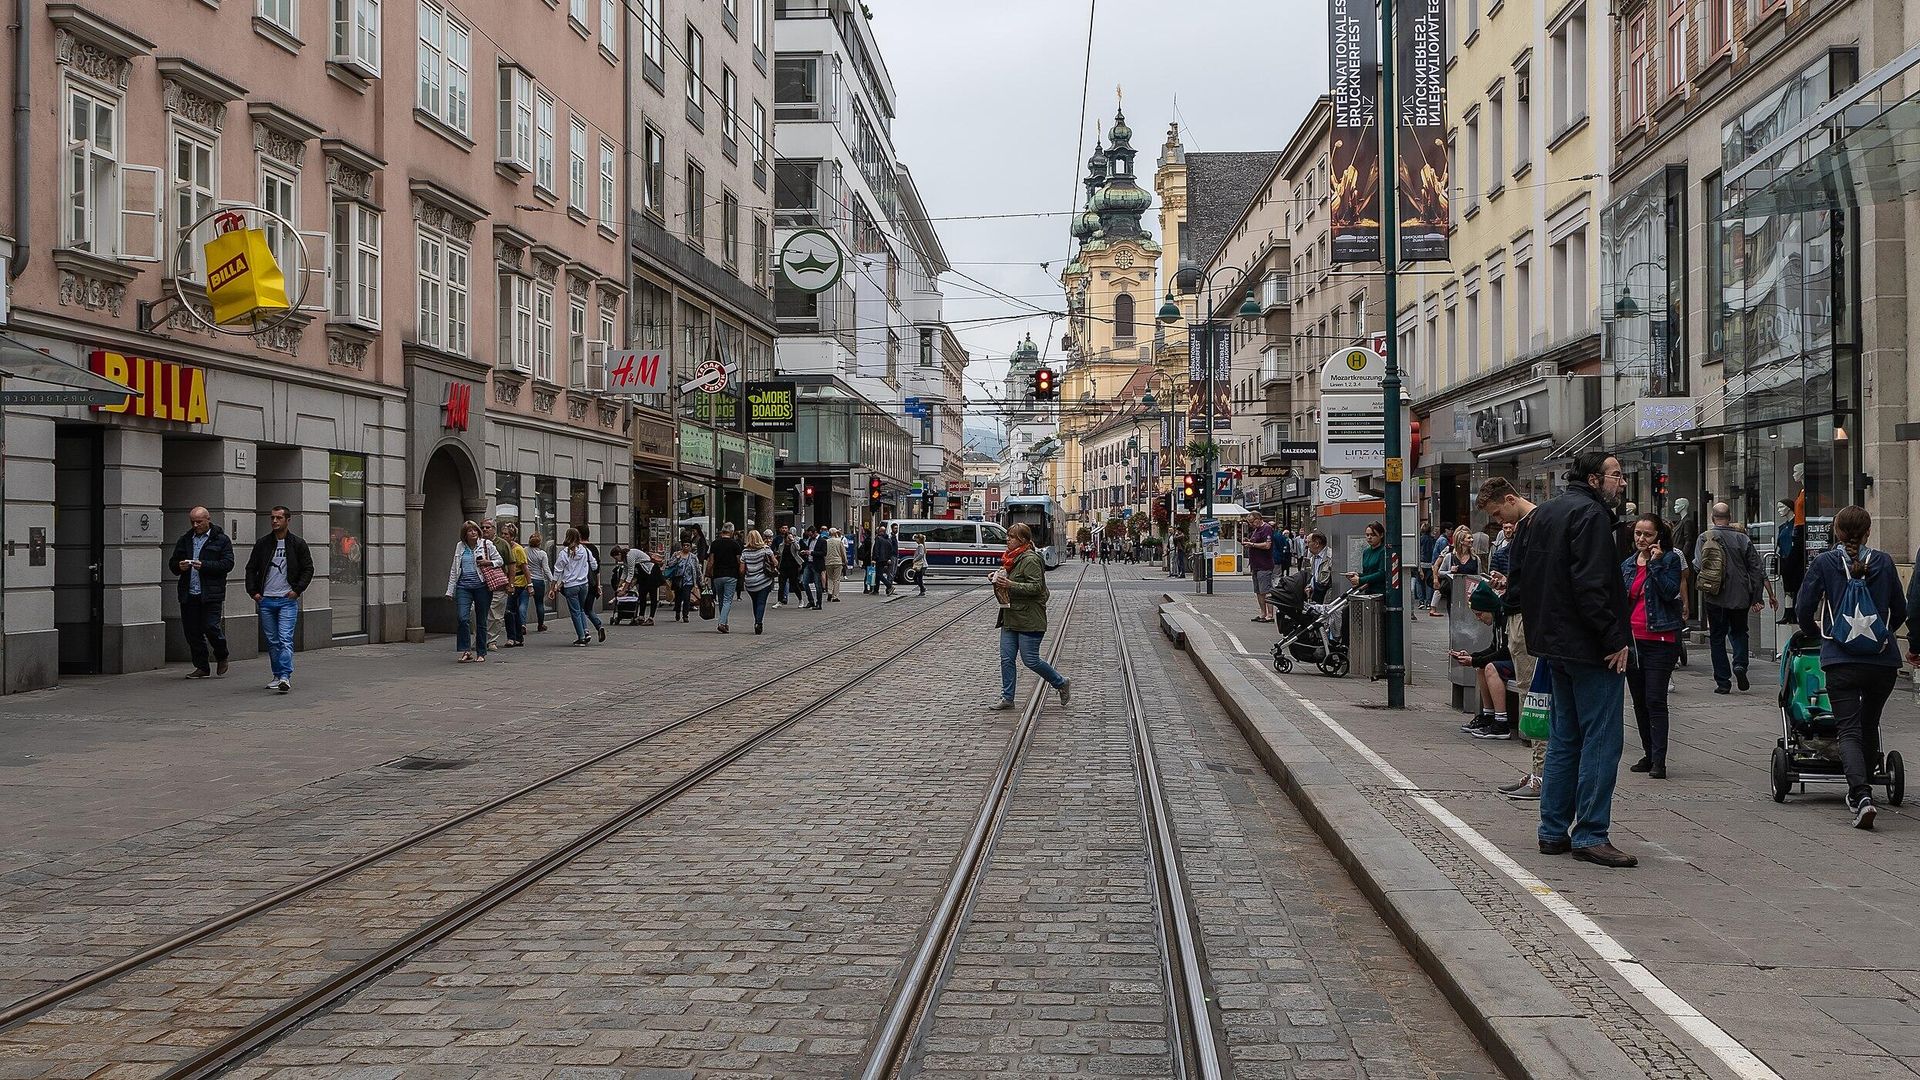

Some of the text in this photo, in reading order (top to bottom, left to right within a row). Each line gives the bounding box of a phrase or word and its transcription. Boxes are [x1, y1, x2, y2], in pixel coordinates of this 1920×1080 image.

[1335, 0, 1348, 128] INTERNATIONALES
[1348, 17, 1361, 127] BRUCKNERFEST
[1363, 96, 1374, 127] LINZ
[209, 254, 248, 291] BILLA
[611, 354, 660, 388] H&M
[103, 351, 209, 425] BILLA
[762, 391, 789, 404] MORE
[752, 404, 790, 417] BOARDS
[1325, 476, 1343, 499] 3
[955, 556, 995, 564] POLIZEI
